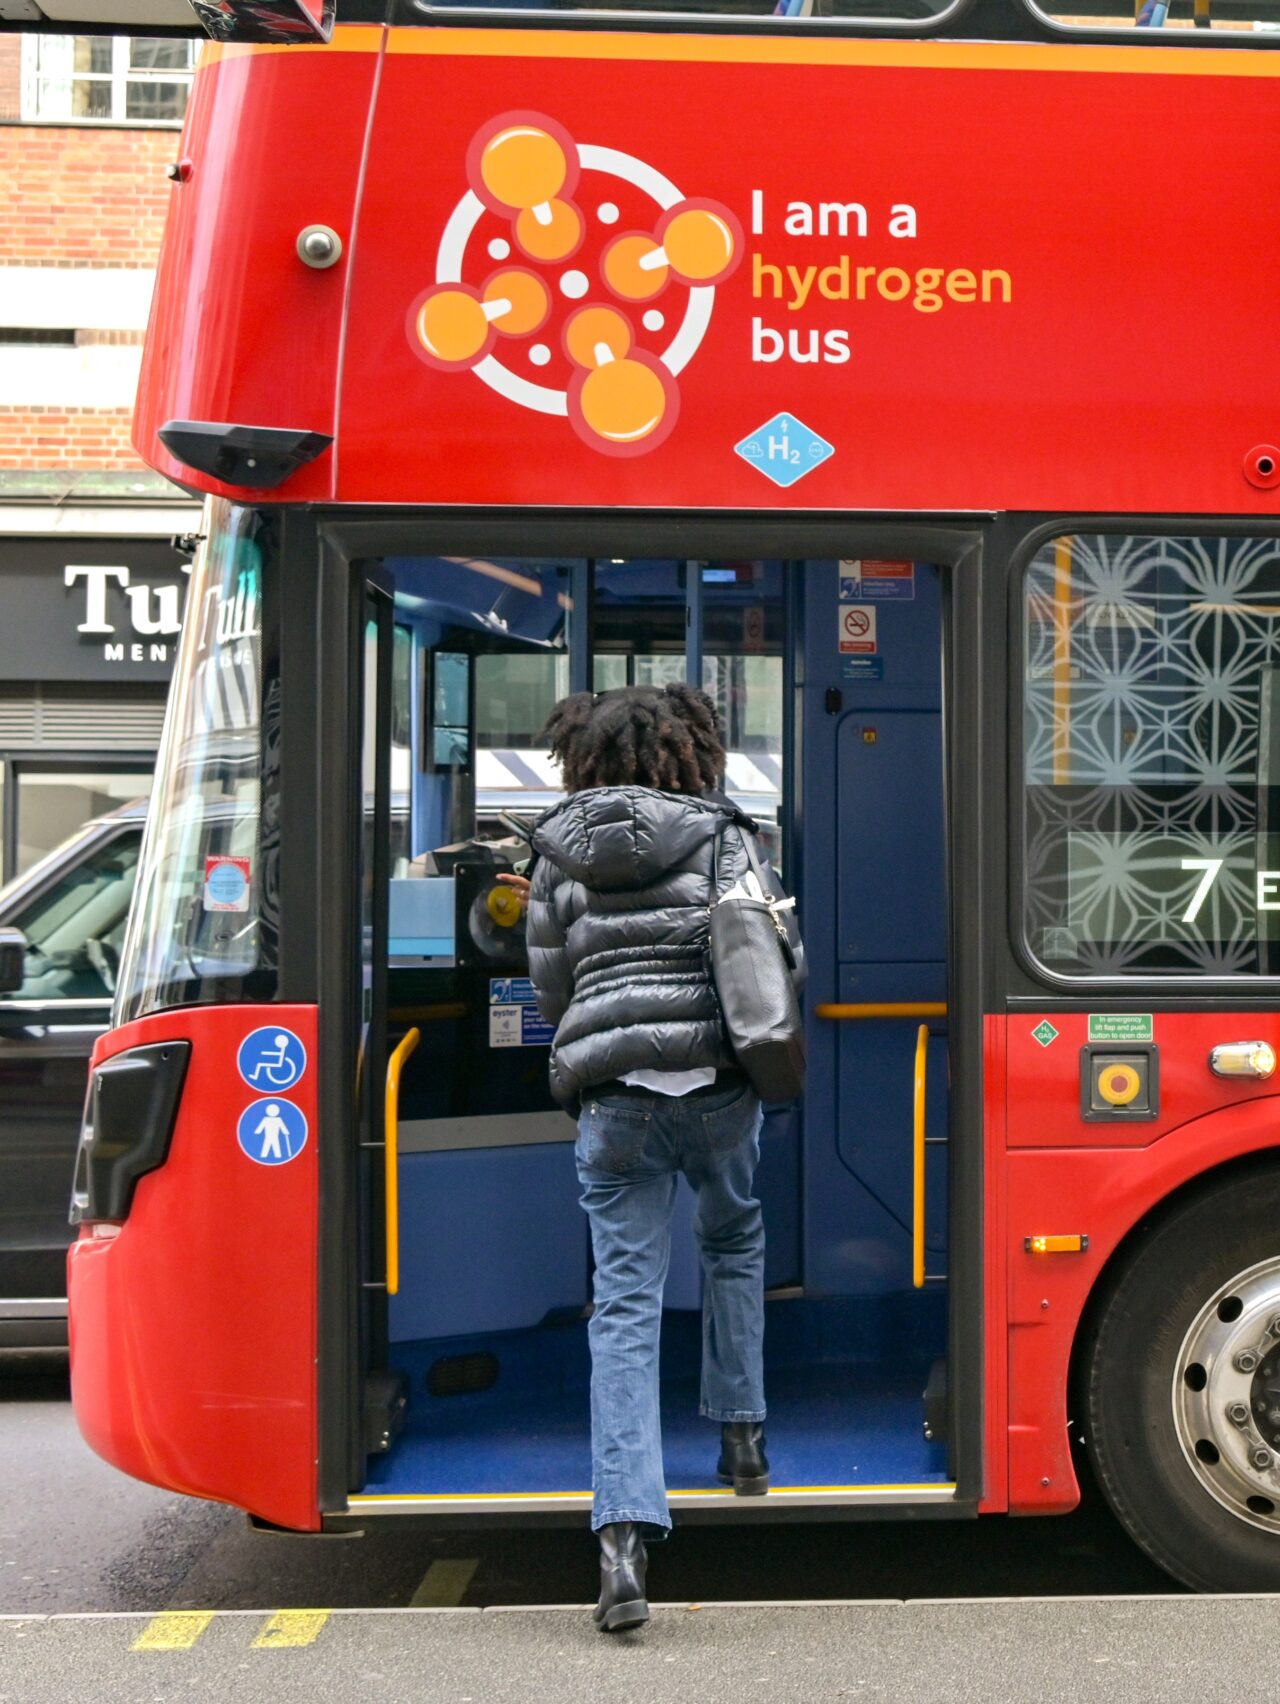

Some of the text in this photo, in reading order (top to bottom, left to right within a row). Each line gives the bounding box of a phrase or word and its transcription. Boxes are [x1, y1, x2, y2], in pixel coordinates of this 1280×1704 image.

[752, 189, 917, 238] I am a
[752, 253, 1012, 313] hydrogen
[752, 316, 851, 364] bus
[1181, 858, 1224, 923] 7
